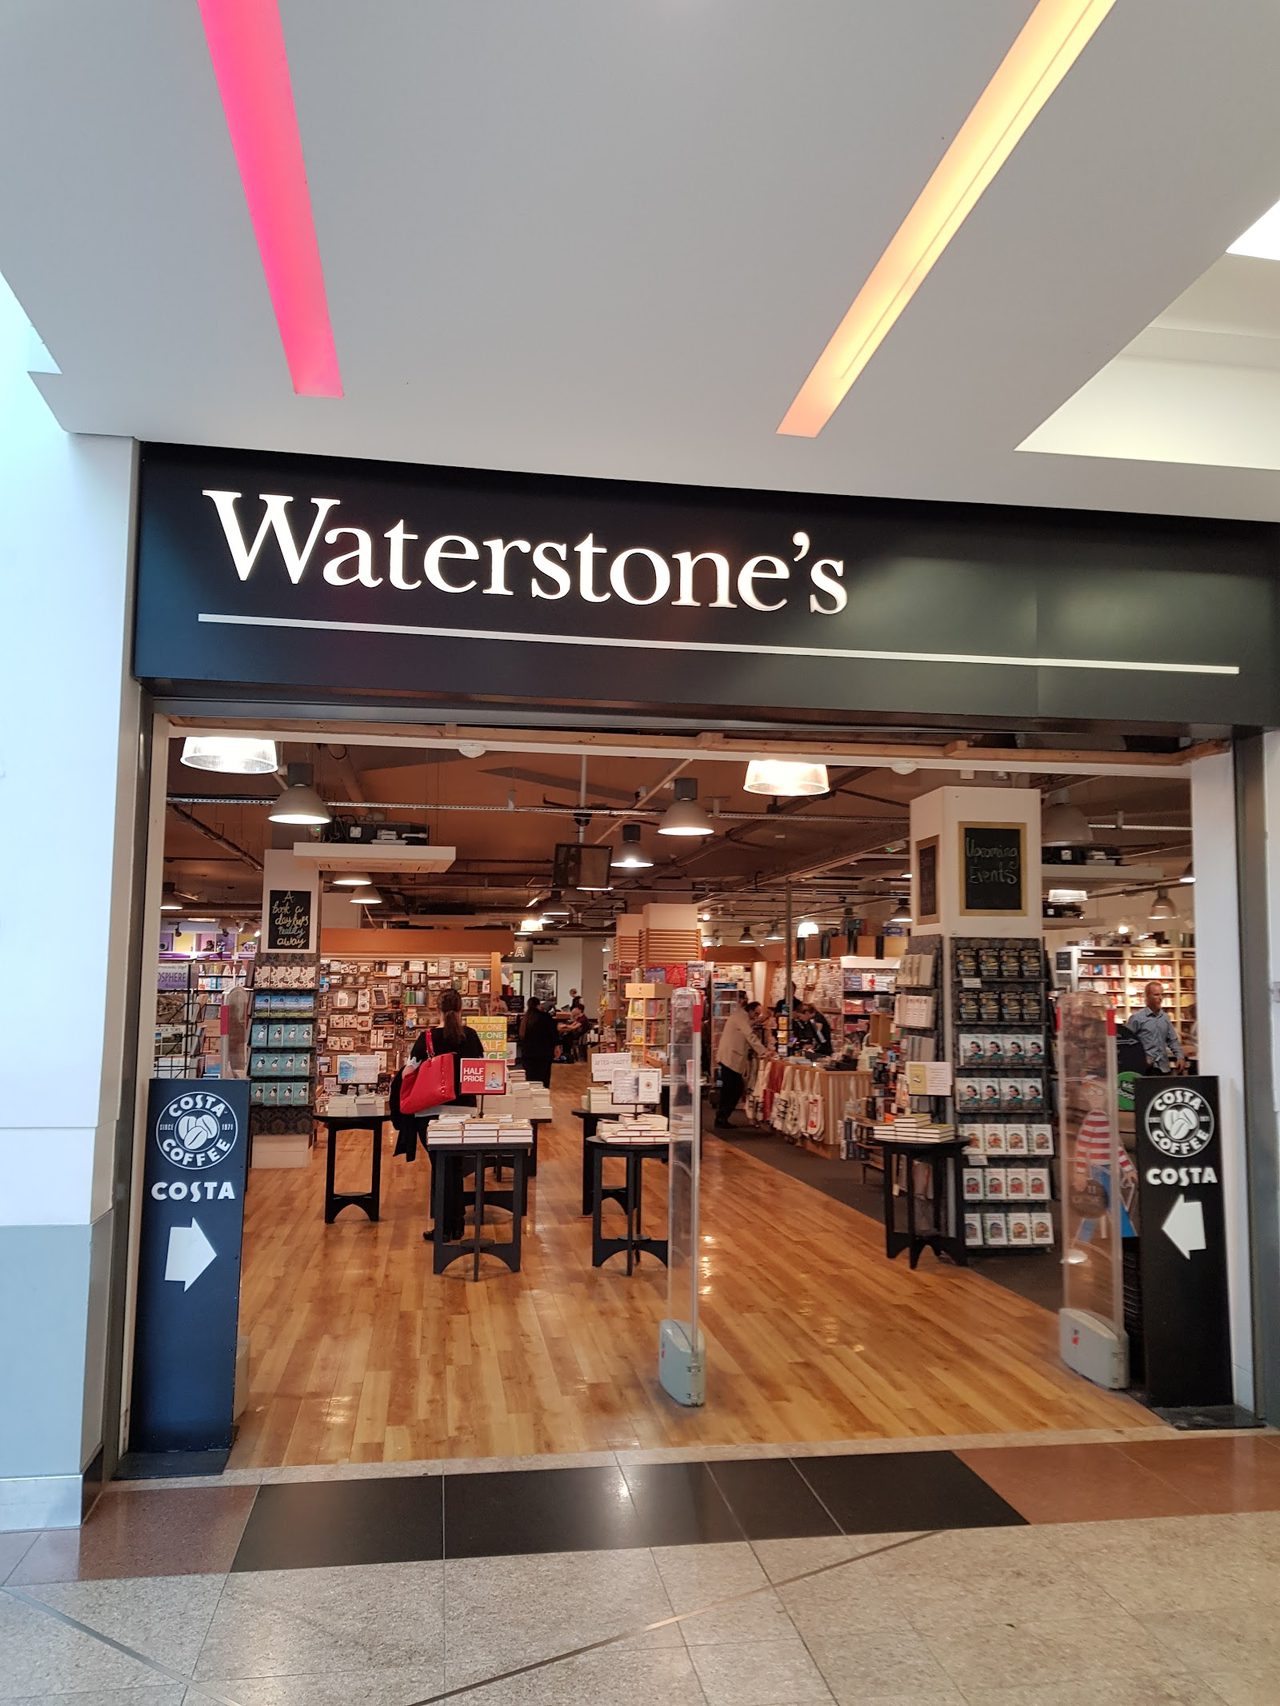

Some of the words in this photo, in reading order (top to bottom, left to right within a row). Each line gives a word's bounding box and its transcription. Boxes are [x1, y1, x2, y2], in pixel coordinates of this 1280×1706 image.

[201, 489, 848, 614] Waterstone's
[966, 837, 1018, 862] Upcoming
[969, 860, 1018, 884] Events
[282, 891, 294, 903] A
[277, 938, 306, 948] away
[482, 1040, 502, 1050] ALF
[463, 1067, 485, 1075] HALF
[168, 1095, 226, 1118] COSTA
[1153, 1090, 1202, 1112] COSTA
[1151, 1128, 1210, 1155] COFFEE
[162, 1139, 231, 1167] COFFEE
[1146, 1167, 1218, 1187] COSTA
[151, 1181, 236, 1203] COSTA
